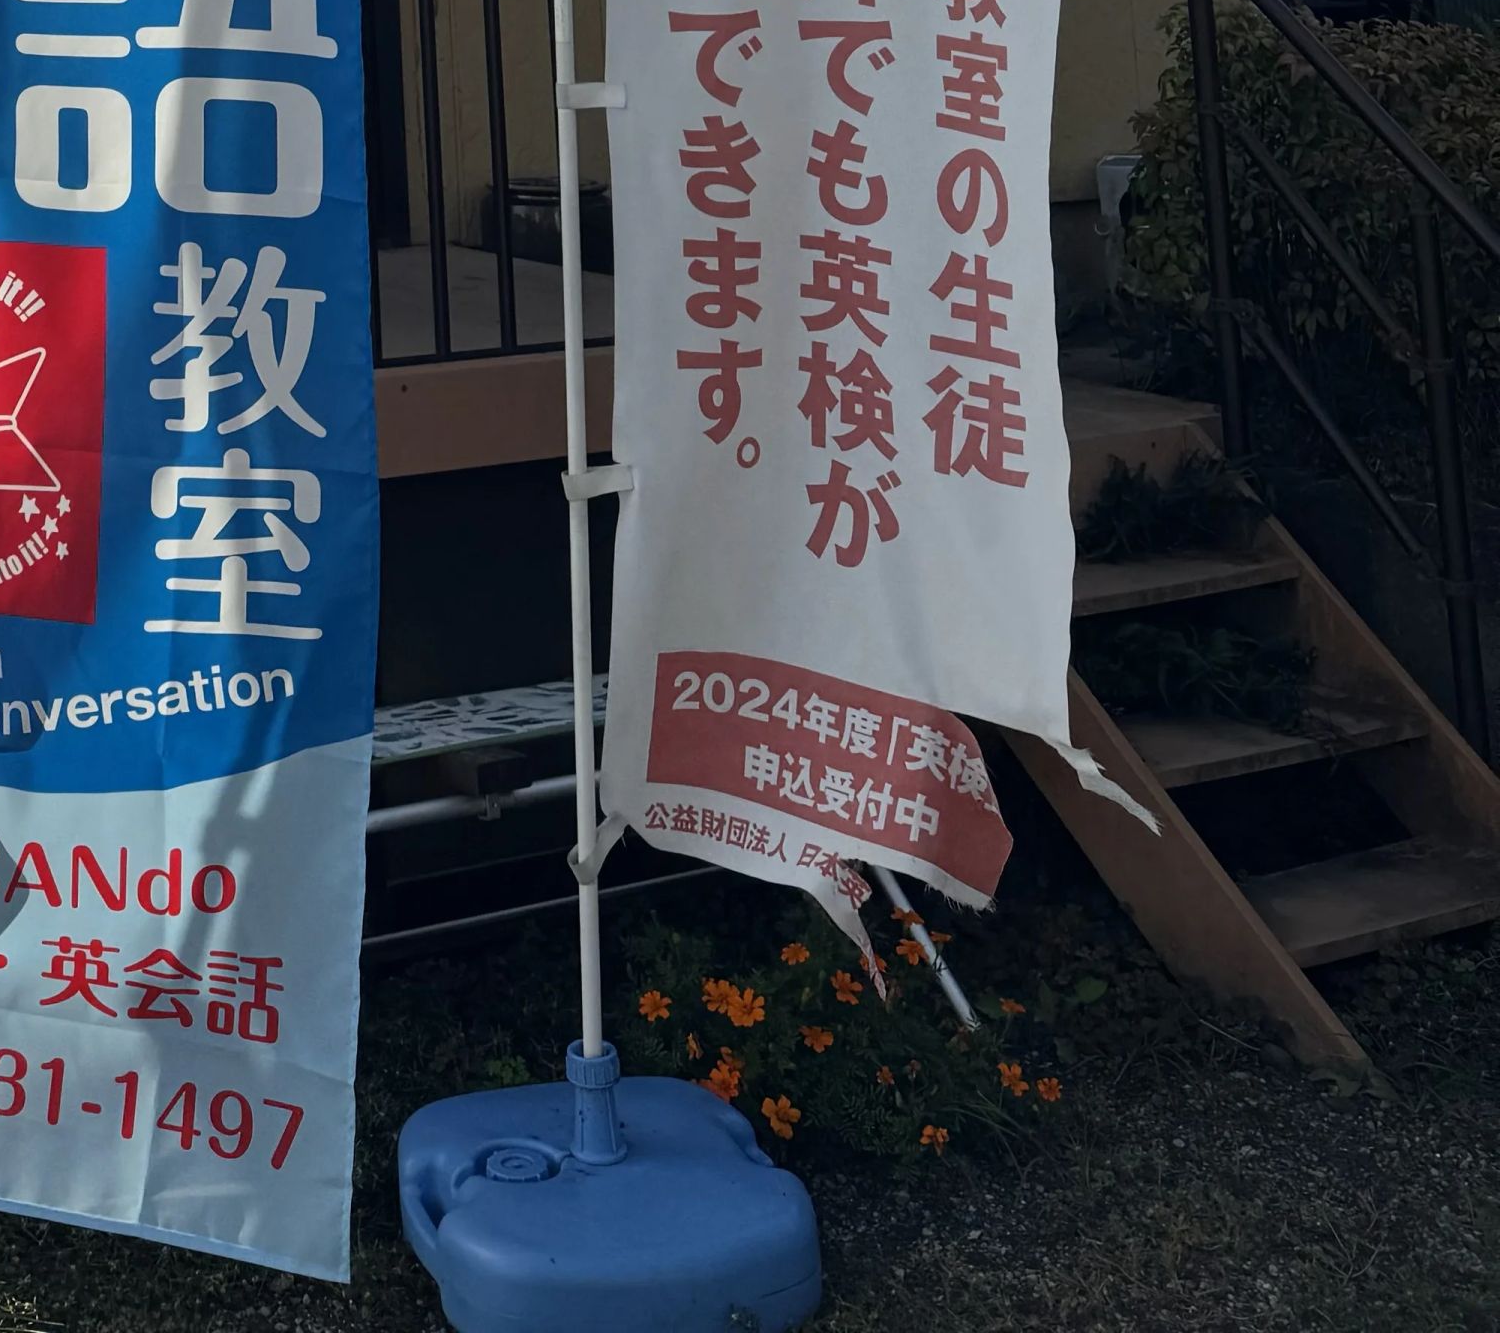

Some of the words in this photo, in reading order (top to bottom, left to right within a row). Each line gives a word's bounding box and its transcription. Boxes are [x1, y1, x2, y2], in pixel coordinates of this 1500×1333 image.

[18, 531, 49, 566] it!
[743, 743, 940, 843] 申込受付中
[644, 802, 788, 863] 公益財団法人
